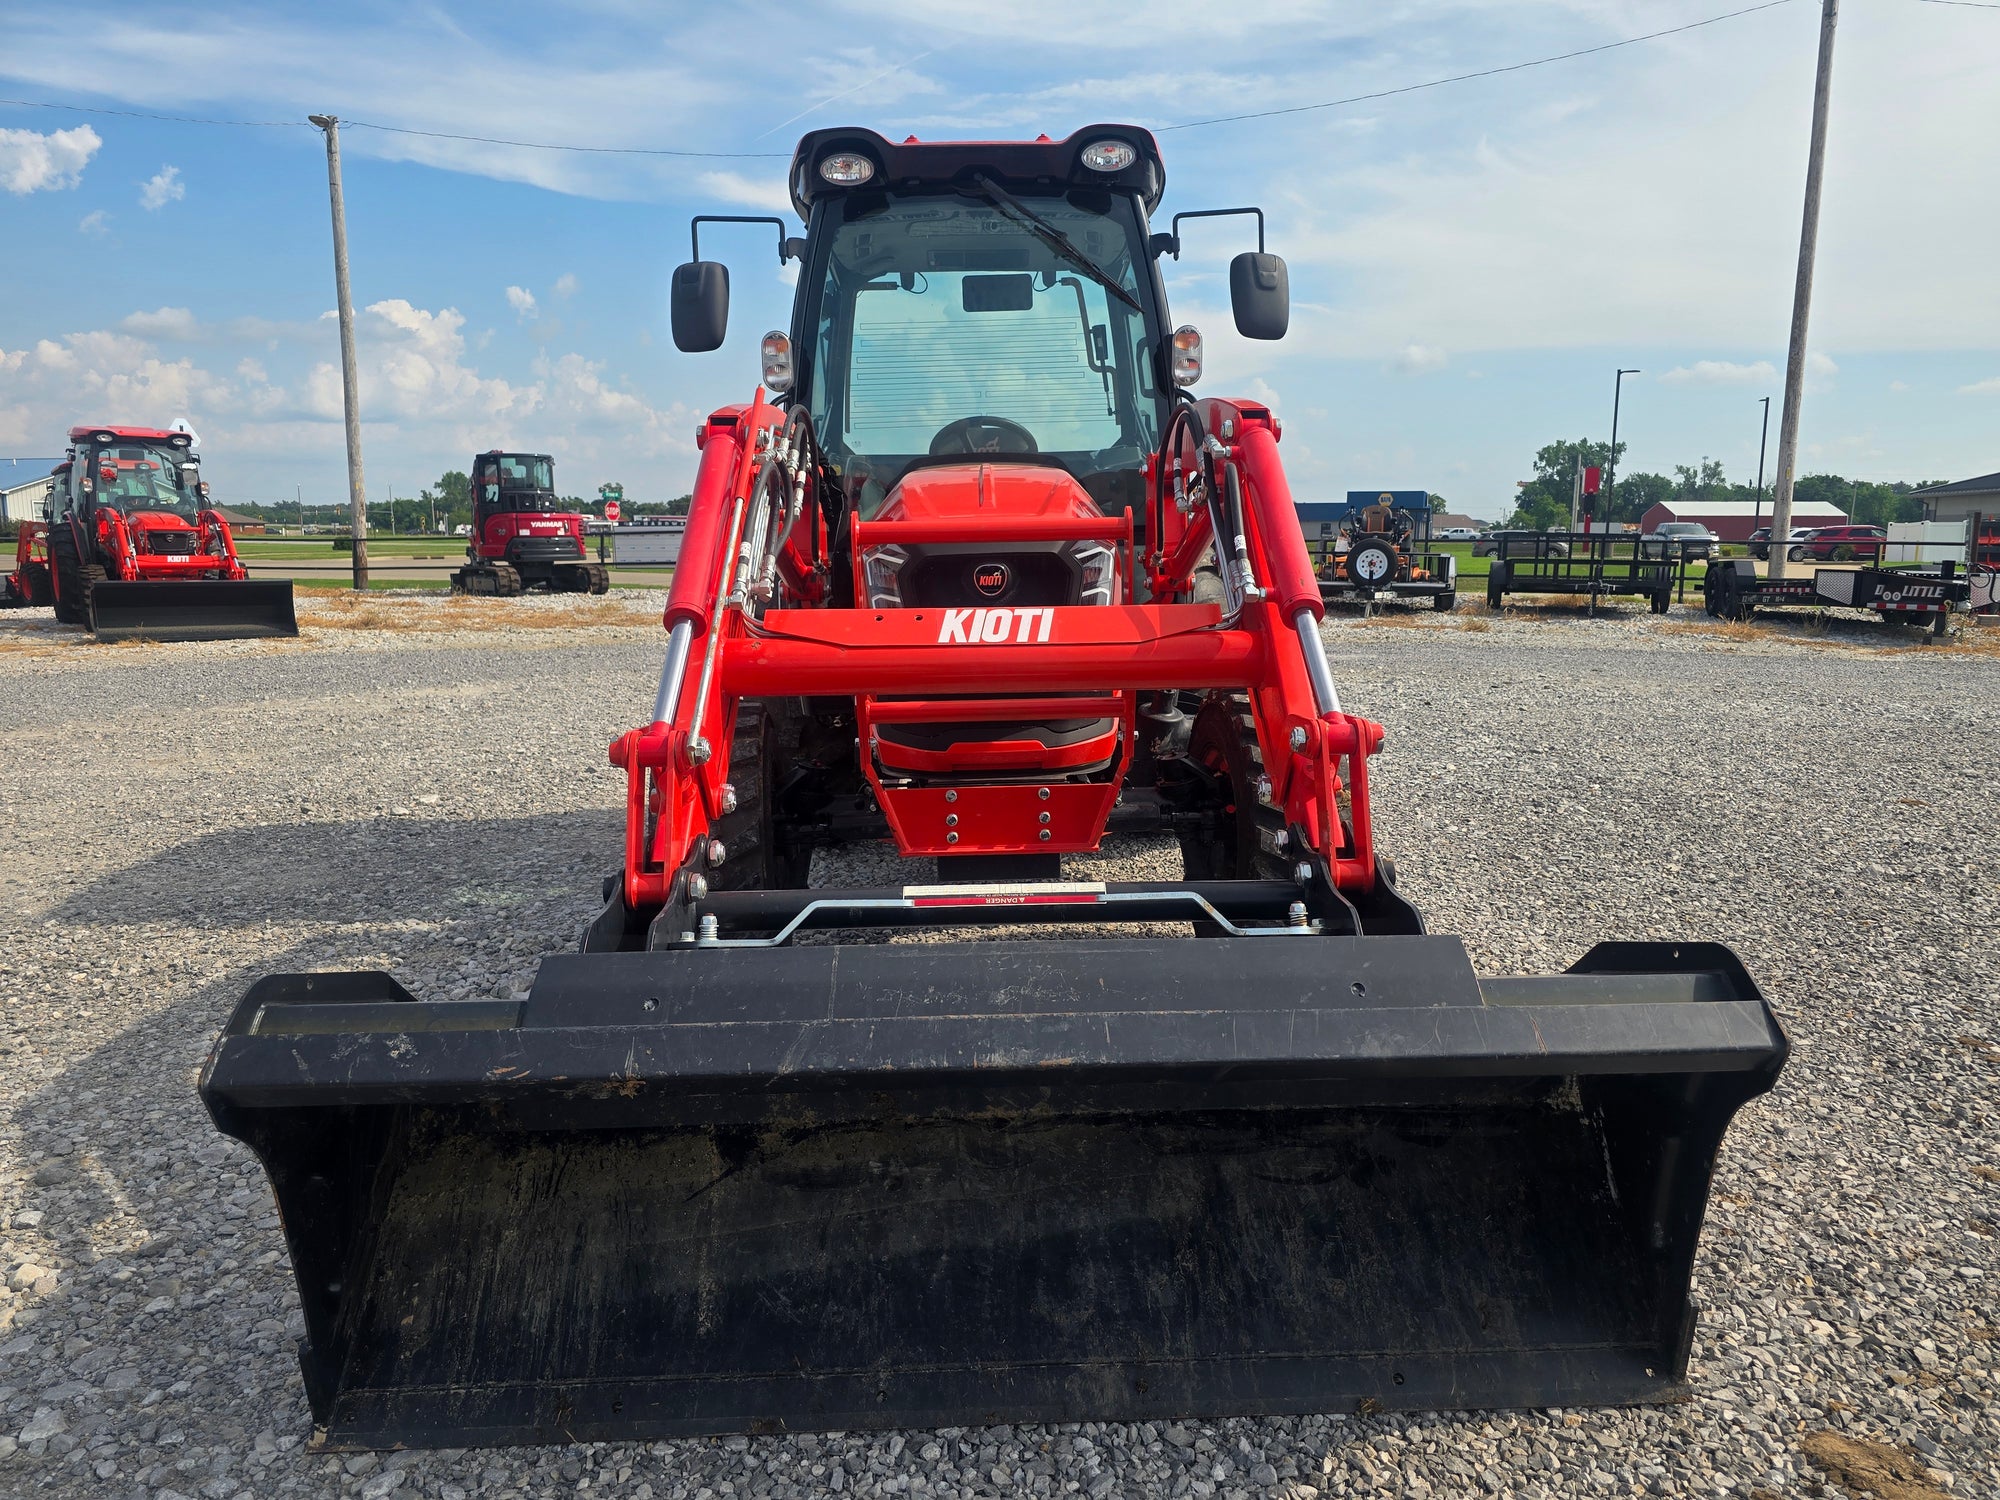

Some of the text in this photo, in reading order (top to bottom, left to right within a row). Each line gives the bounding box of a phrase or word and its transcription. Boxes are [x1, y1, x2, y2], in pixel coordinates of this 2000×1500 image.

[606, 506, 620, 516] STOP
[167, 555, 189, 563] KIOTI
[979, 575, 1002, 586] KIOTI
[937, 607, 1055, 643] KIOTI
[985, 897, 1018, 905] DANGER
